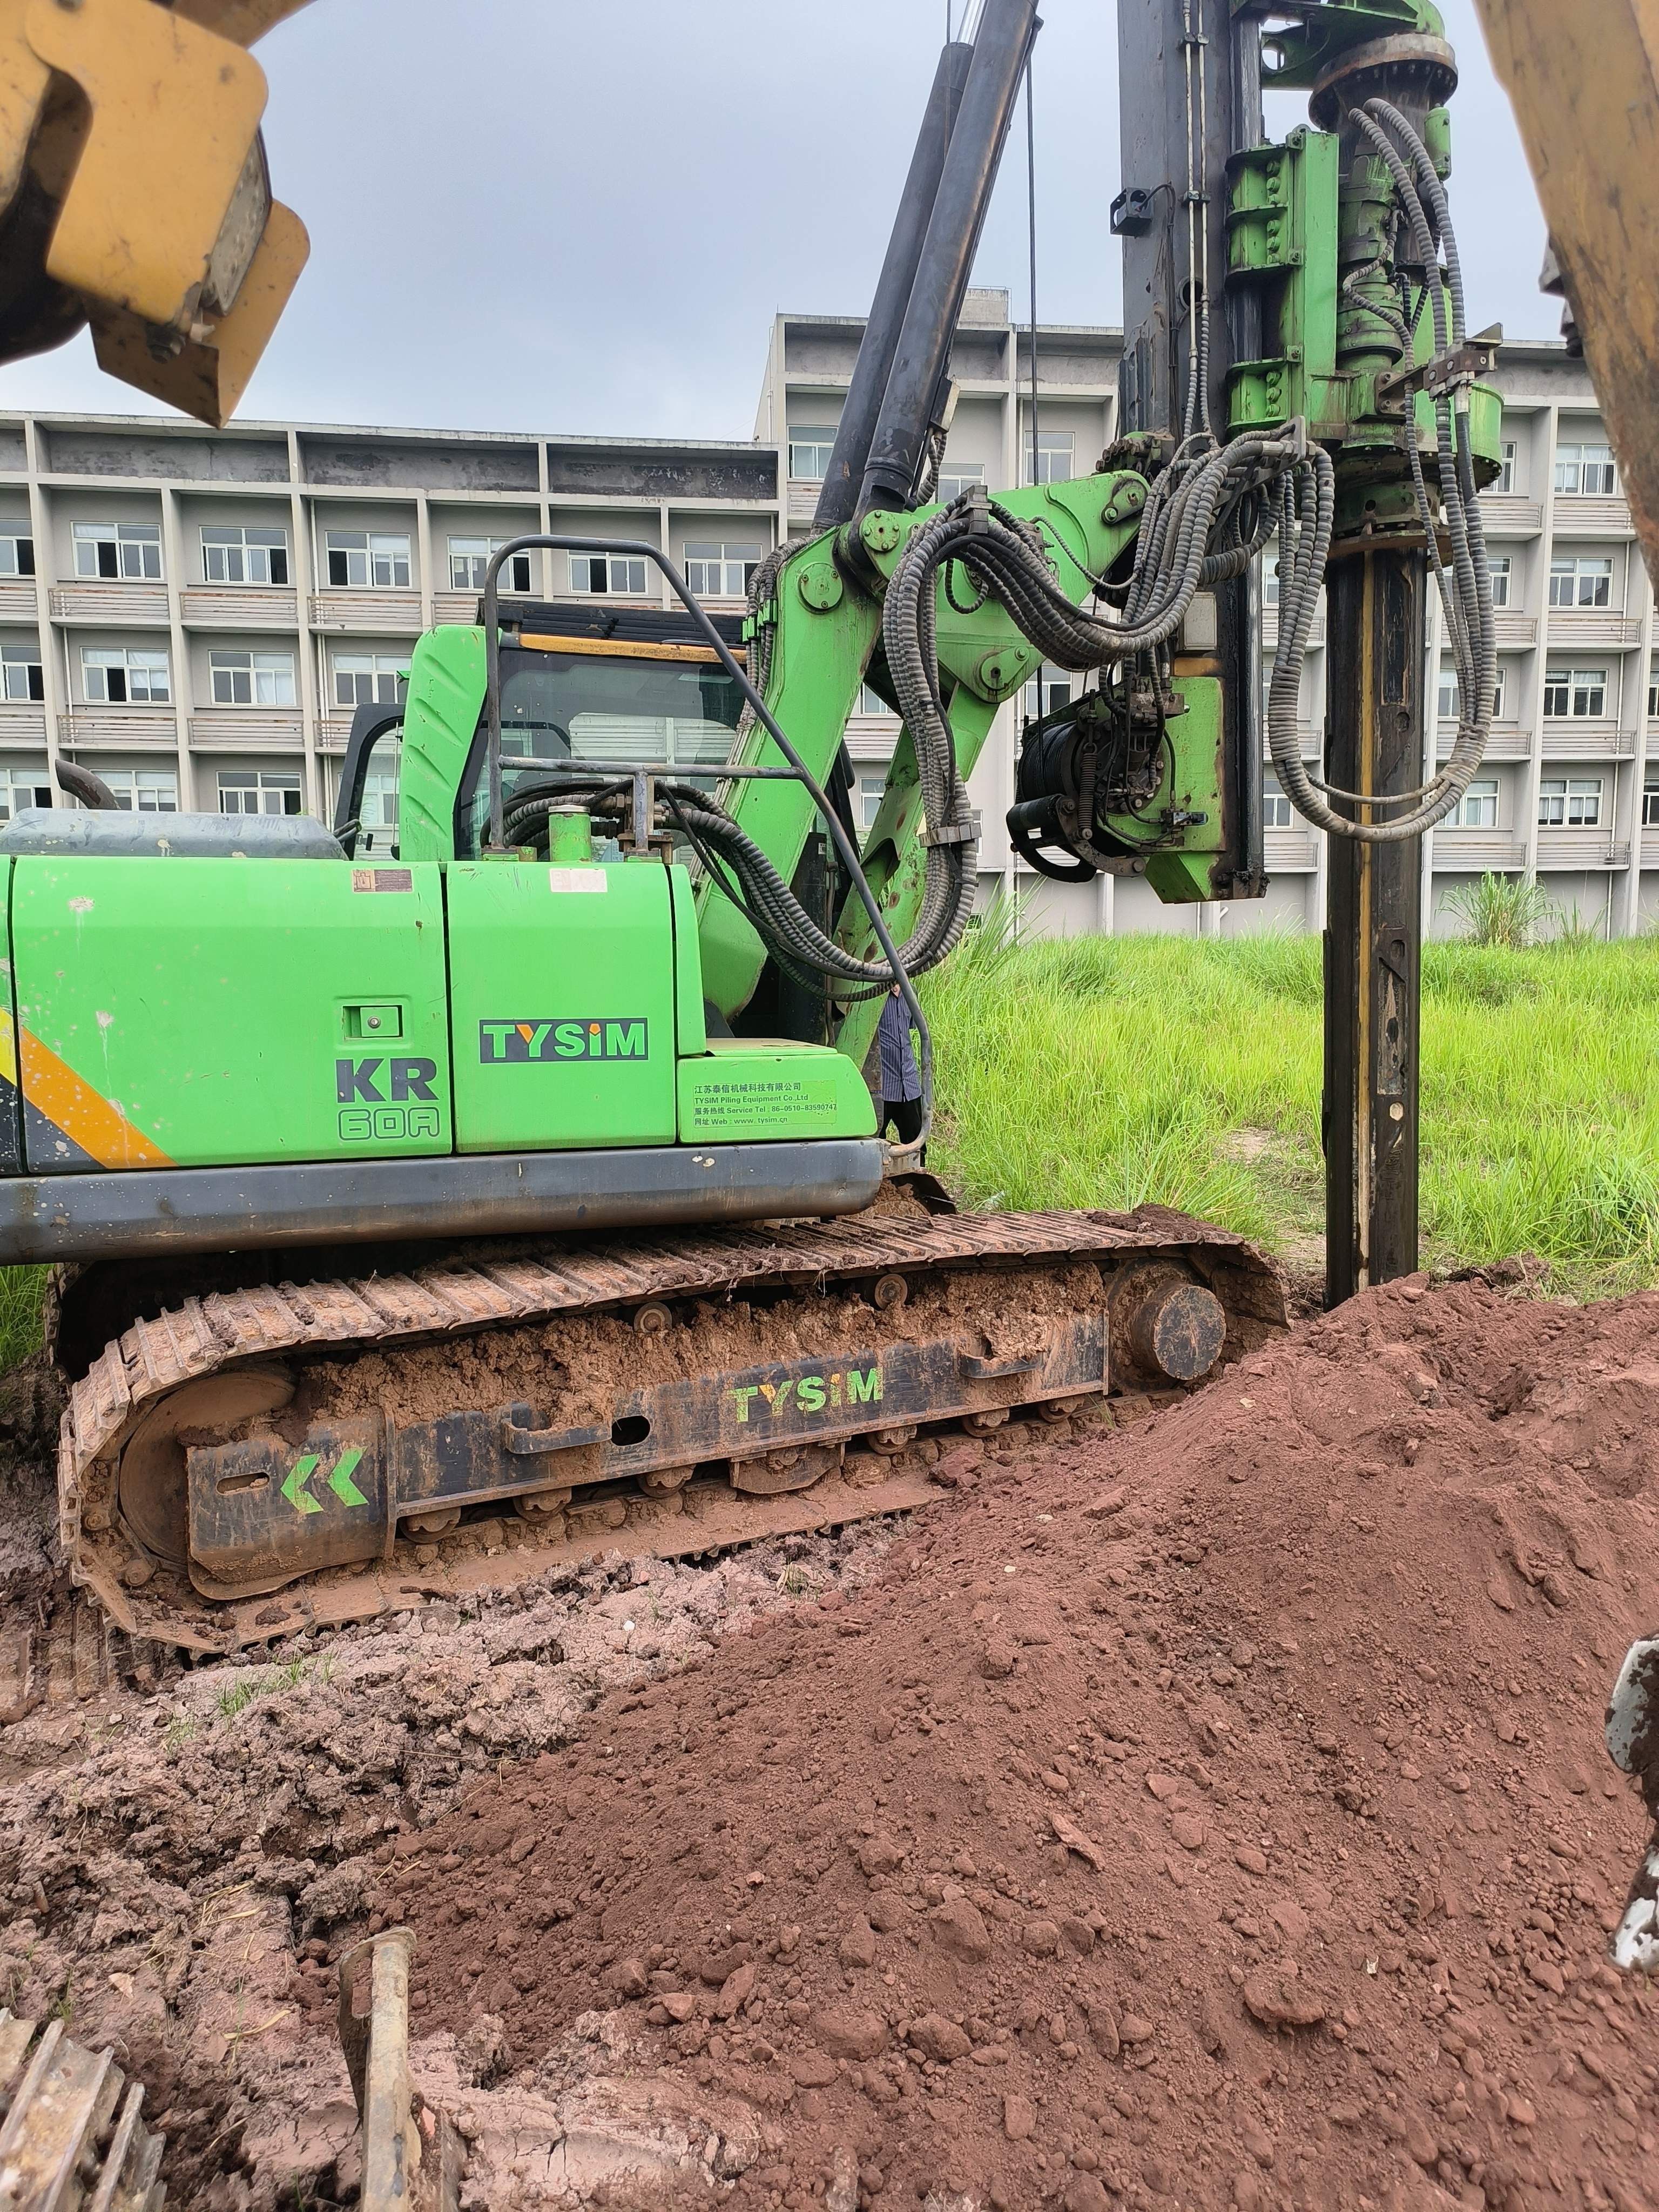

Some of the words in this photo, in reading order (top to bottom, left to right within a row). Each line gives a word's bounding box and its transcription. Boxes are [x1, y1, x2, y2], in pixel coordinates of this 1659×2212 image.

[335, 1057, 440, 1103] KR
[694, 1082, 801, 1094] 江苏泰信机械科技有限公司
[720, 1096, 741, 1104] Piling
[743, 1095, 781, 1104] Equipment
[695, 1107, 725, 1115] 服务热线
[338, 1107, 440, 1141] 60A
